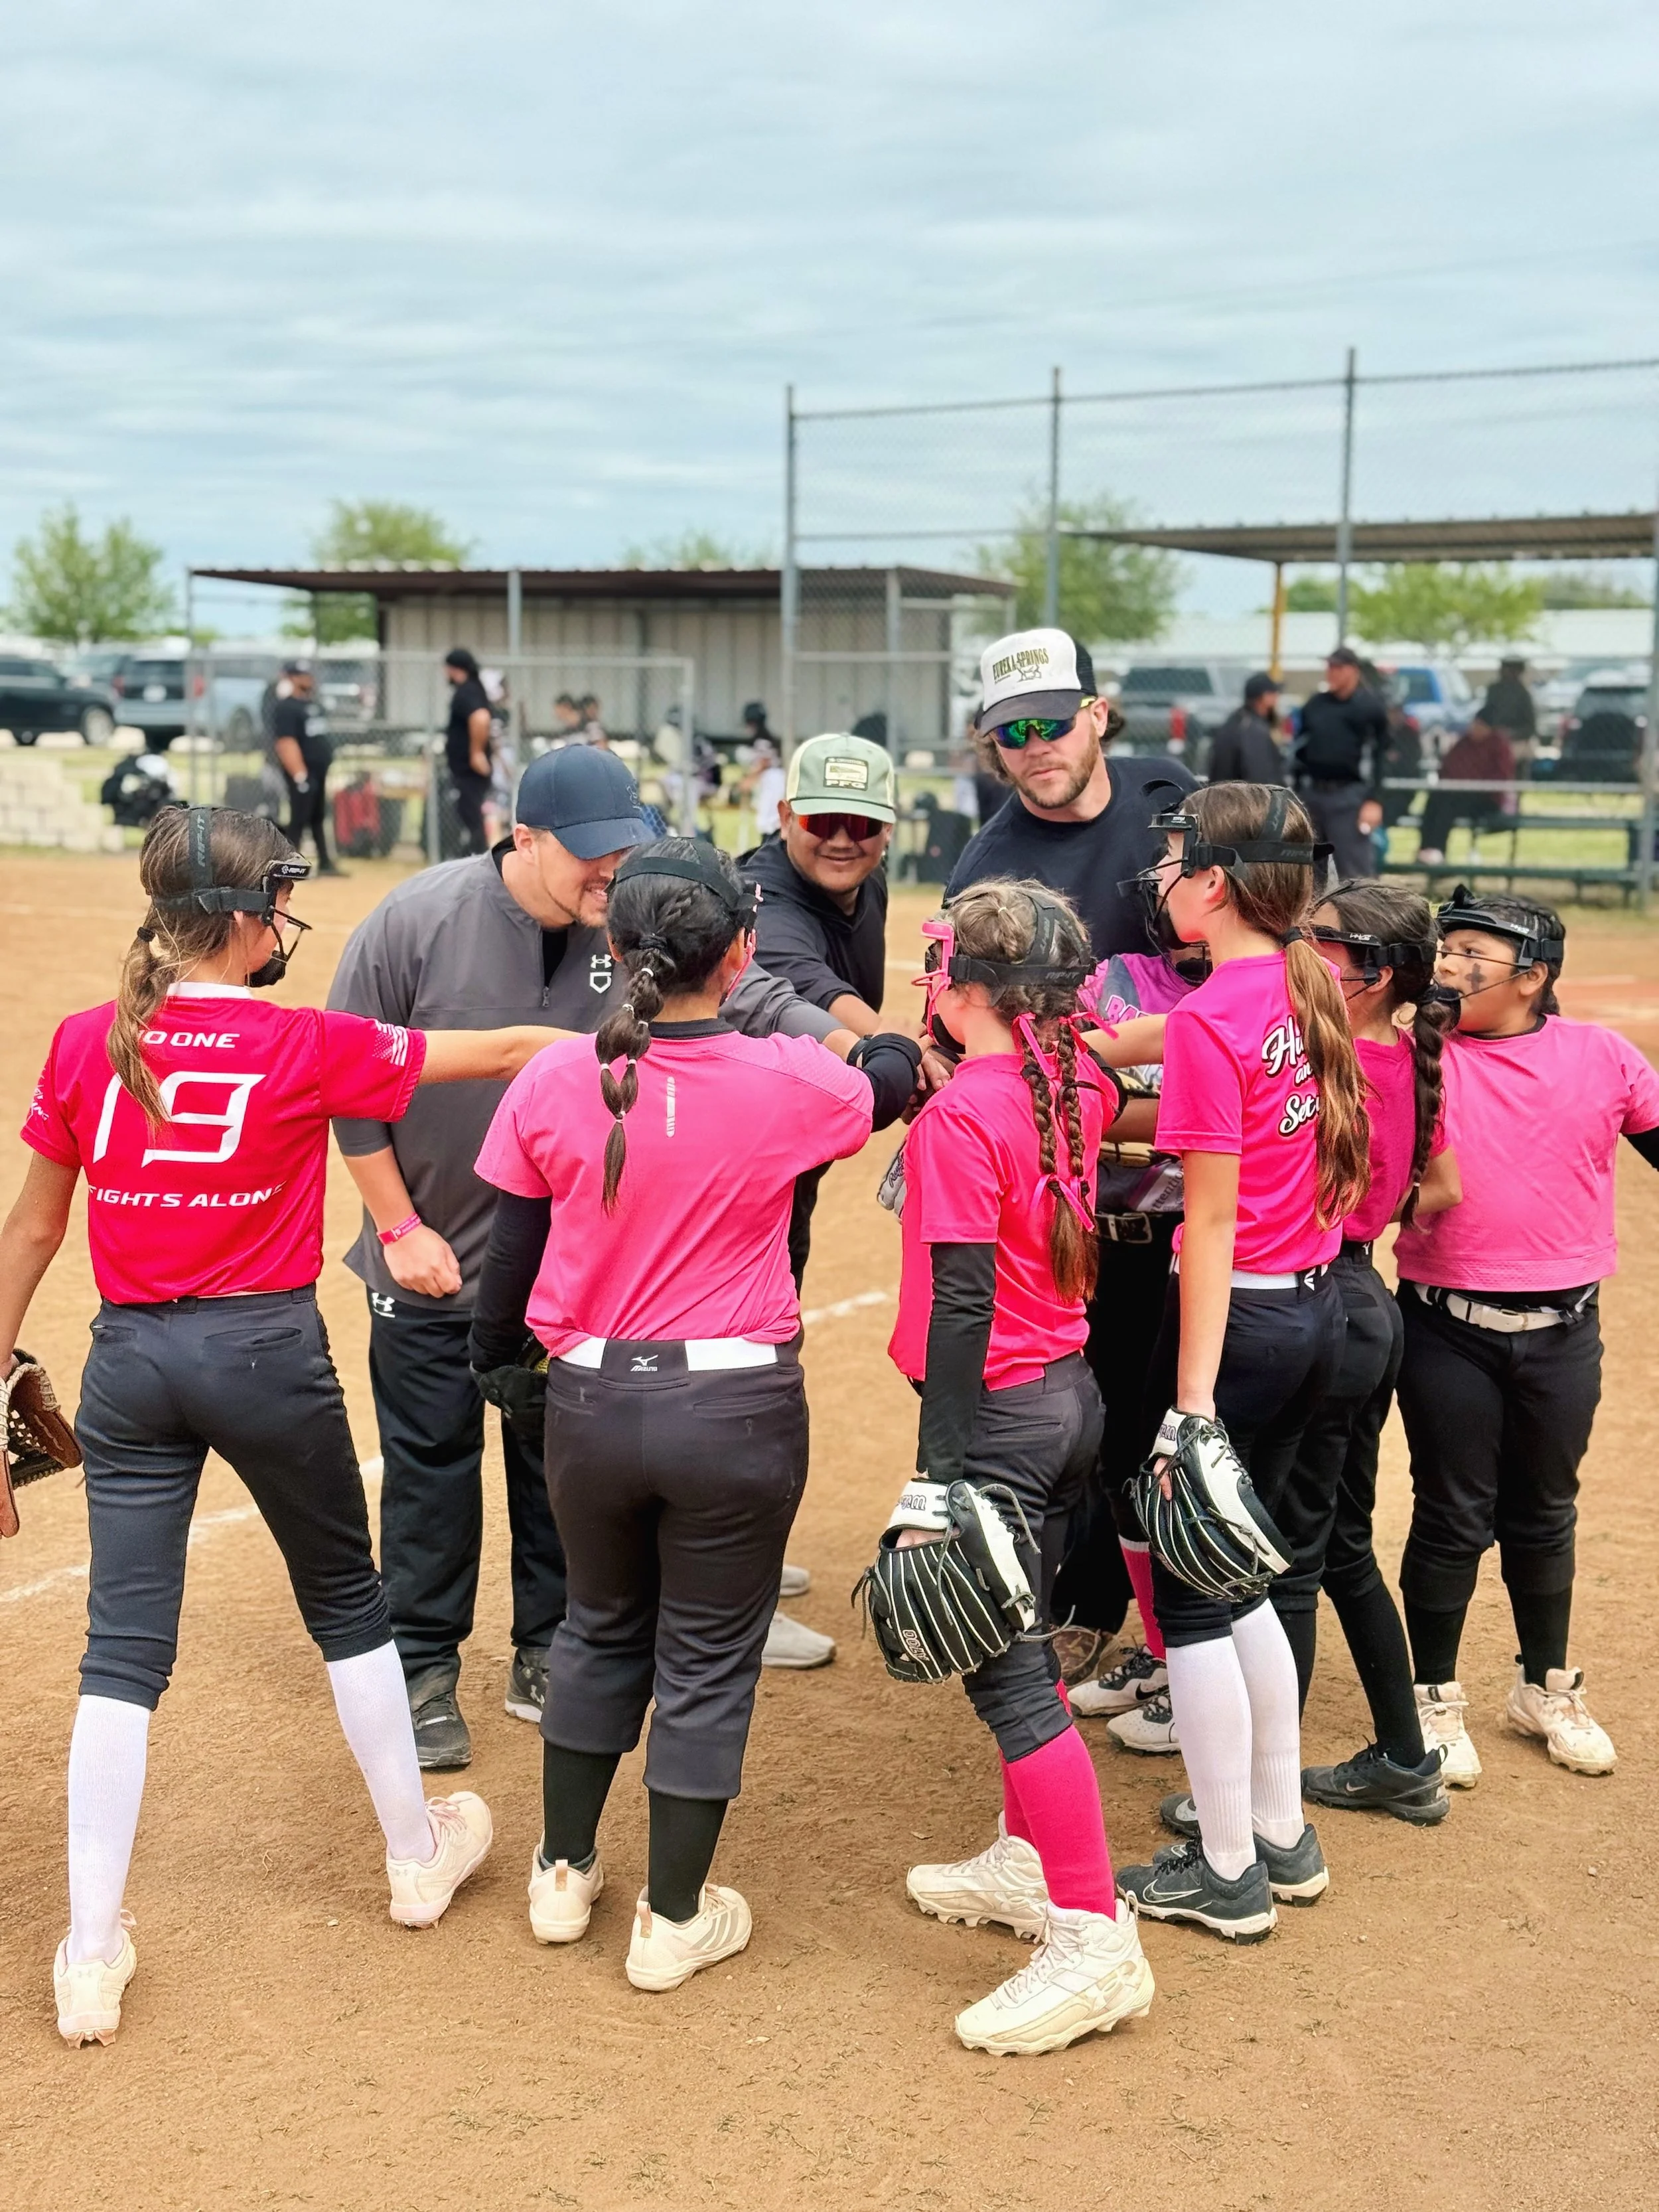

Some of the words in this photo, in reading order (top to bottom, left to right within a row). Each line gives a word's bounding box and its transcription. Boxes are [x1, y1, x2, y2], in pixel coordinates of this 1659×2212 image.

[992, 654, 1017, 680] EUREKA
[1017, 648, 1049, 668] SPRINGS
[826, 779, 865, 789] PFG
[170, 1032, 240, 1049] ONE
[92, 1070, 267, 1168] 19
